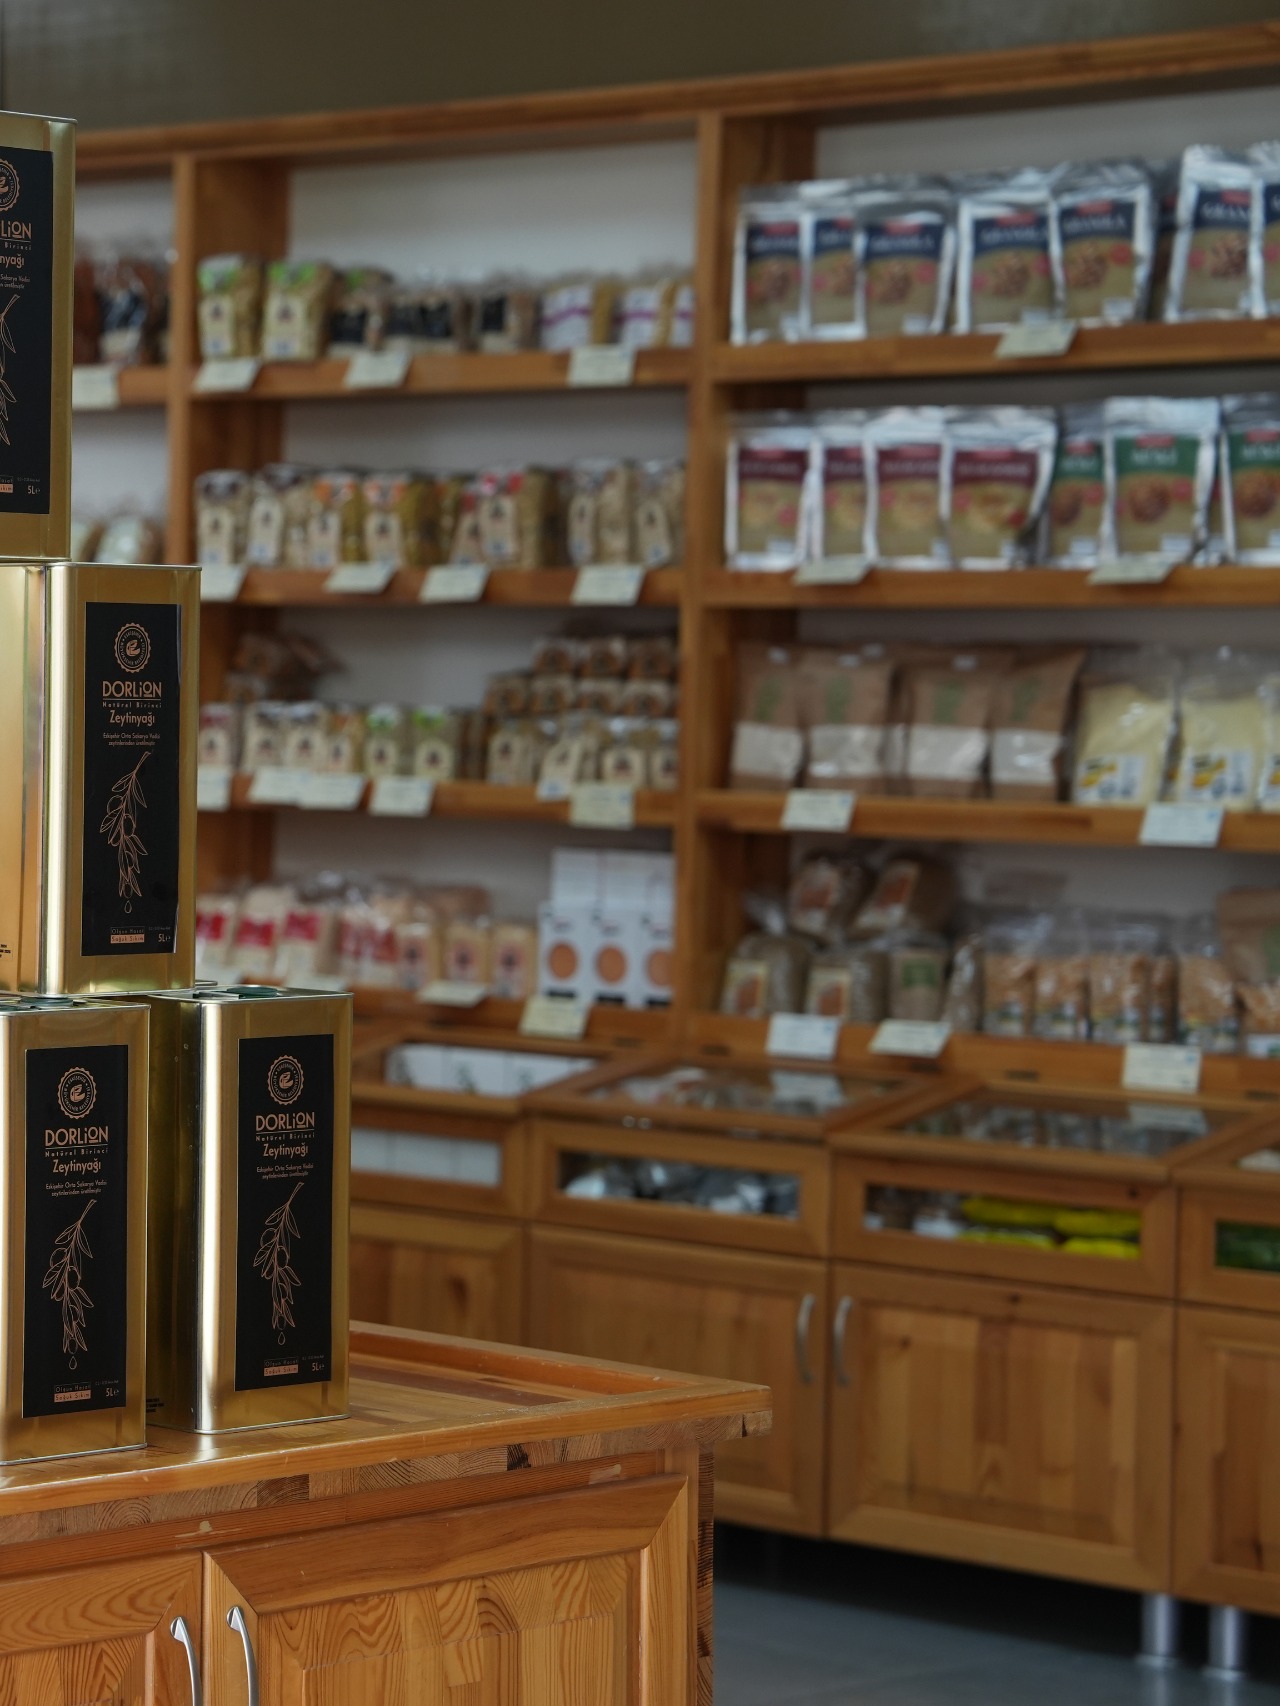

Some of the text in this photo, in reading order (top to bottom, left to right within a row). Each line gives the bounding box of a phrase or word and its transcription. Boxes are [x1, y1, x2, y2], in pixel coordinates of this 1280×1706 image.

[110, 710, 155, 727] Zeytinyağı
[263, 1142, 308, 1160] Zeytinyağı
[53, 1158, 100, 1176] Zeytinyağı
